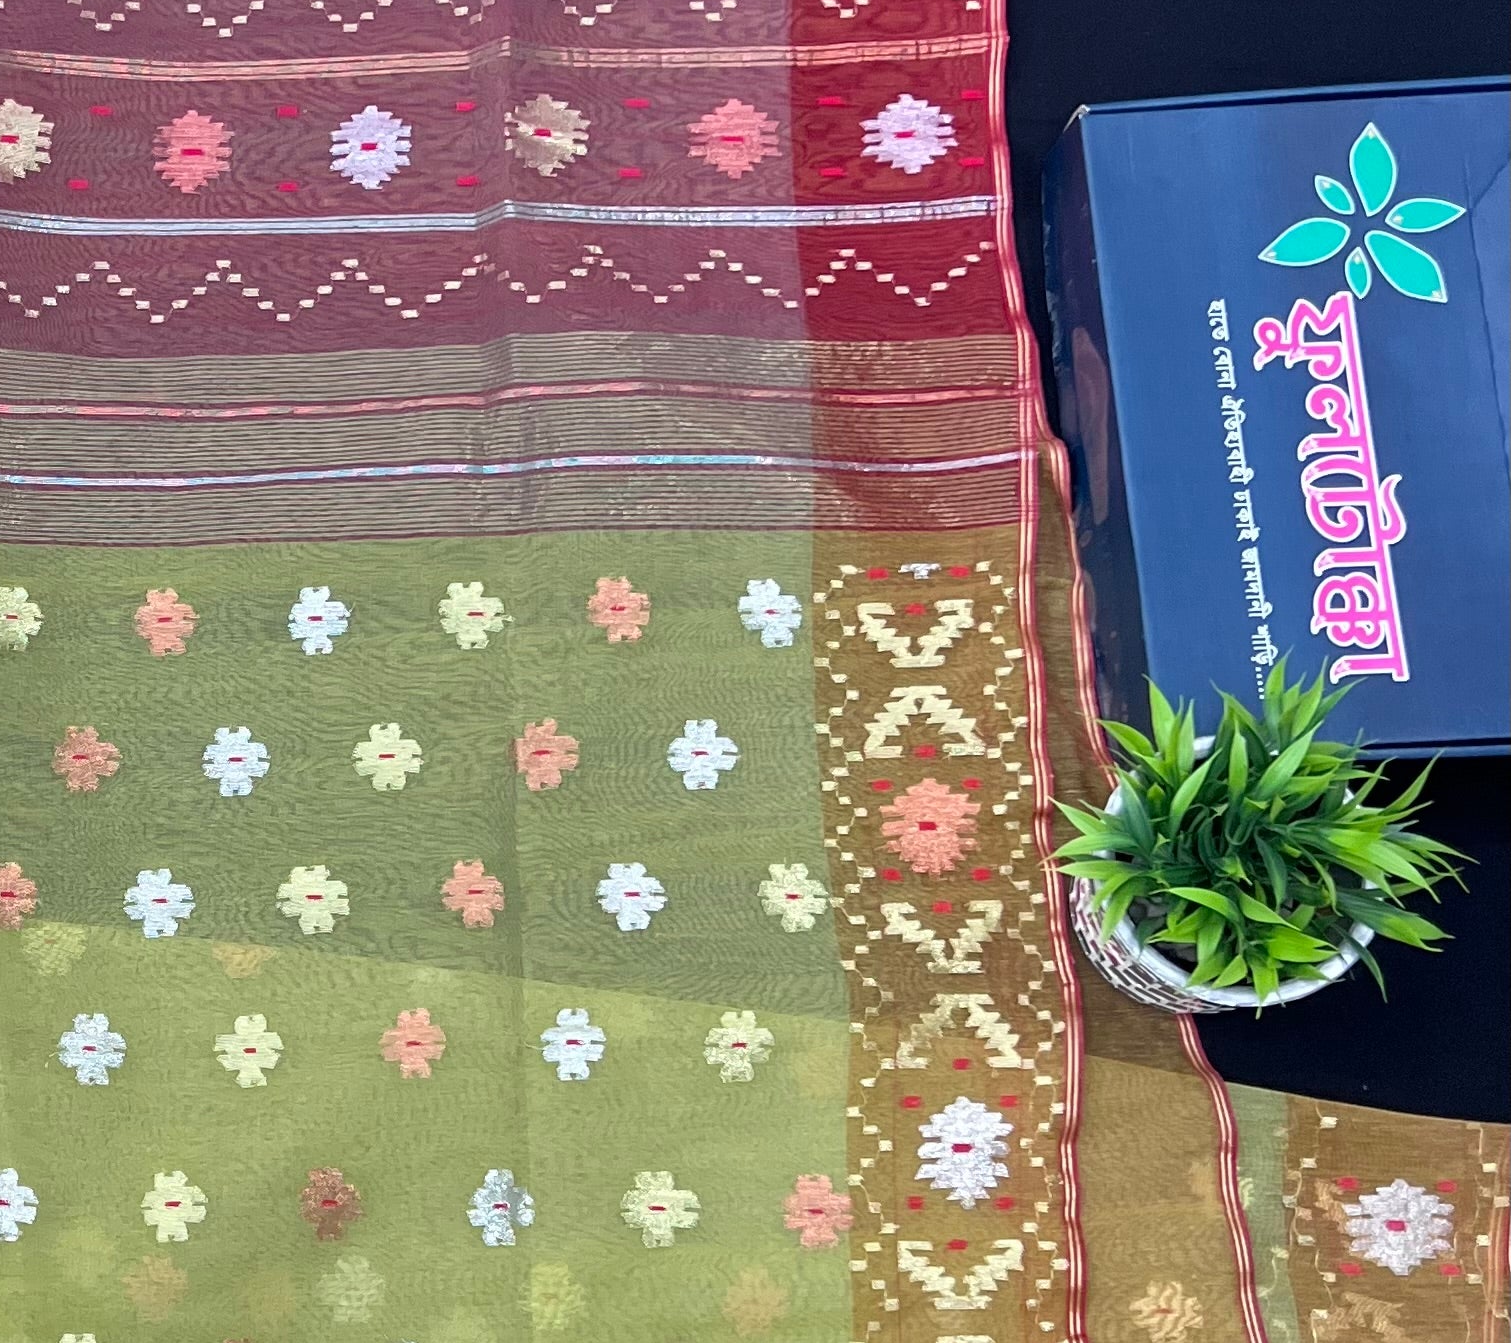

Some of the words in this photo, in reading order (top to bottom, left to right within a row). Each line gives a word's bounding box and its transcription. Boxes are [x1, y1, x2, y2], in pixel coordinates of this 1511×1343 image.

[1207, 298, 1230, 342] হাতে
[1212, 346, 1237, 391] বোনা
[1221, 394, 1255, 485] ঐতিহ্যবাহী
[1233, 489, 1261, 542] ঢাকাই
[1242, 546, 1273, 620] জামদানী
